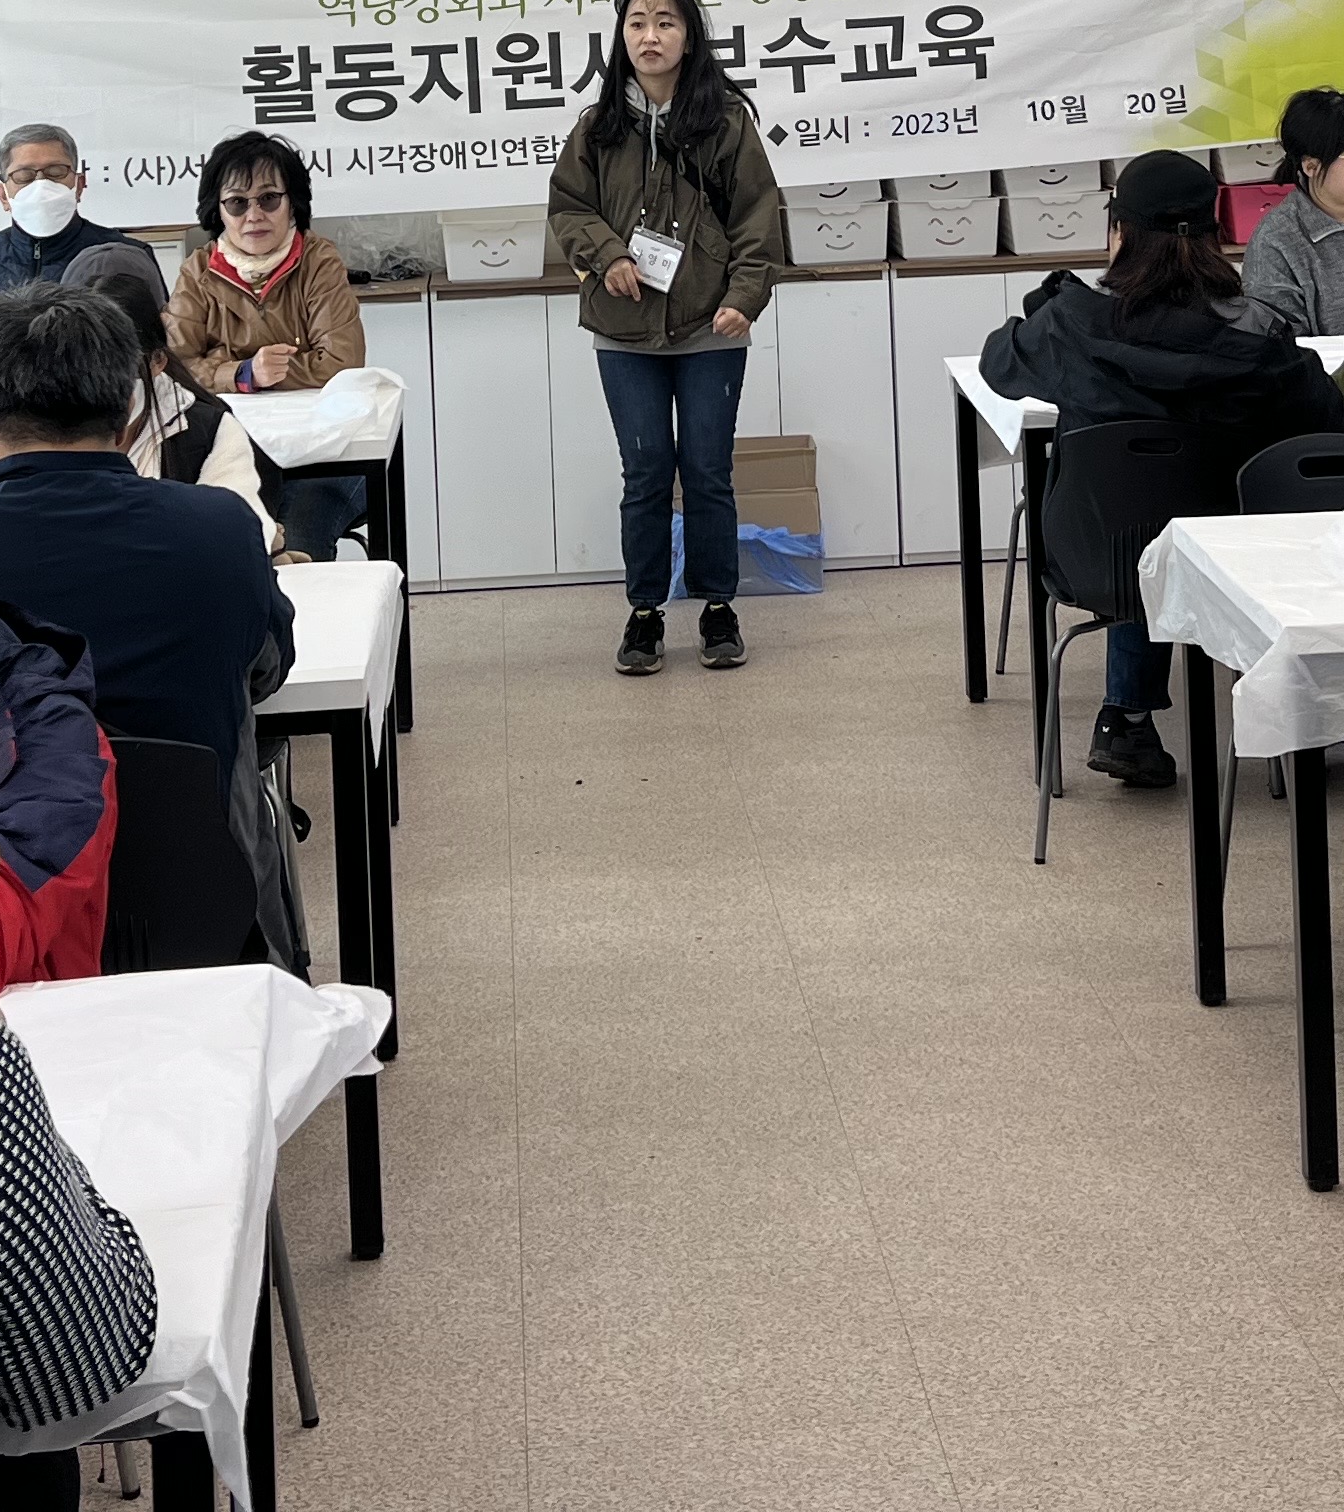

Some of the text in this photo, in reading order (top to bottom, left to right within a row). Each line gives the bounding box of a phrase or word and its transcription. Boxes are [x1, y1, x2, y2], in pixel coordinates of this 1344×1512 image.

[891, 105, 980, 138] 2023년
[1026, 94, 1089, 126] 10월
[1126, 84, 1188, 116] 20일
[346, 134, 568, 175] 시각장애인연합
